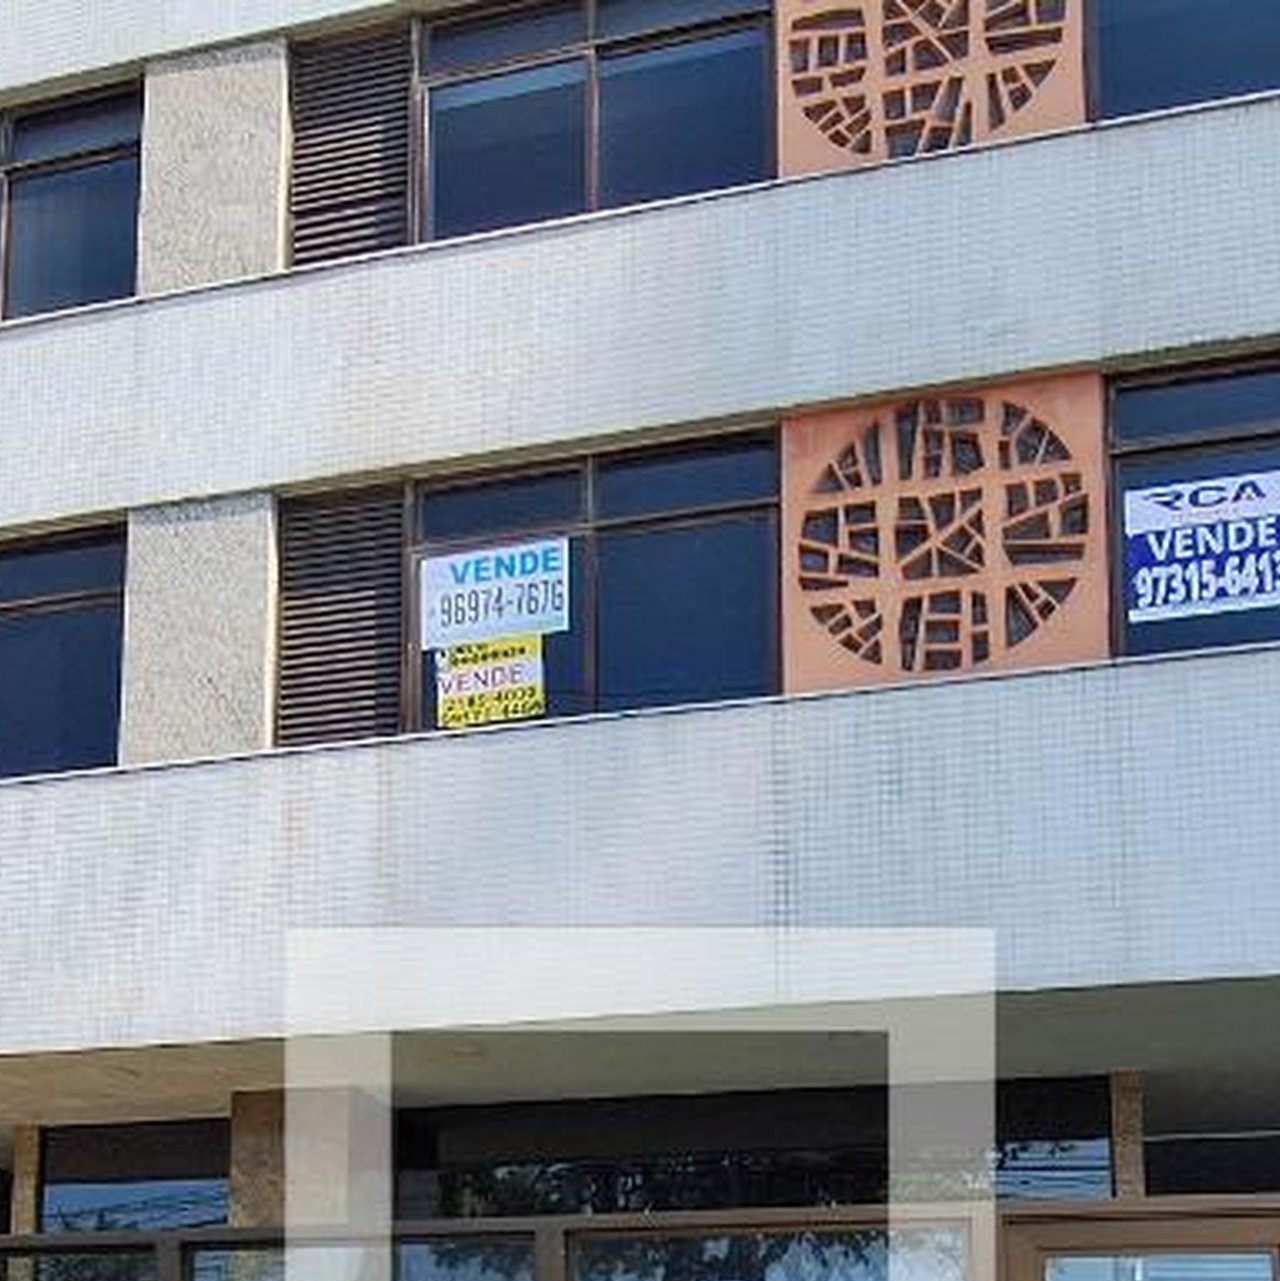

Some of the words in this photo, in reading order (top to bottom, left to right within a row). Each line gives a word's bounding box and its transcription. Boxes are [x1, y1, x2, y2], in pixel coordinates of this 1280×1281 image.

[1144, 481, 1266, 511] RCA
[1147, 517, 1277, 561] VENDE
[450, 548, 560, 584] VENDE
[440, 663, 523, 694] VENDE
